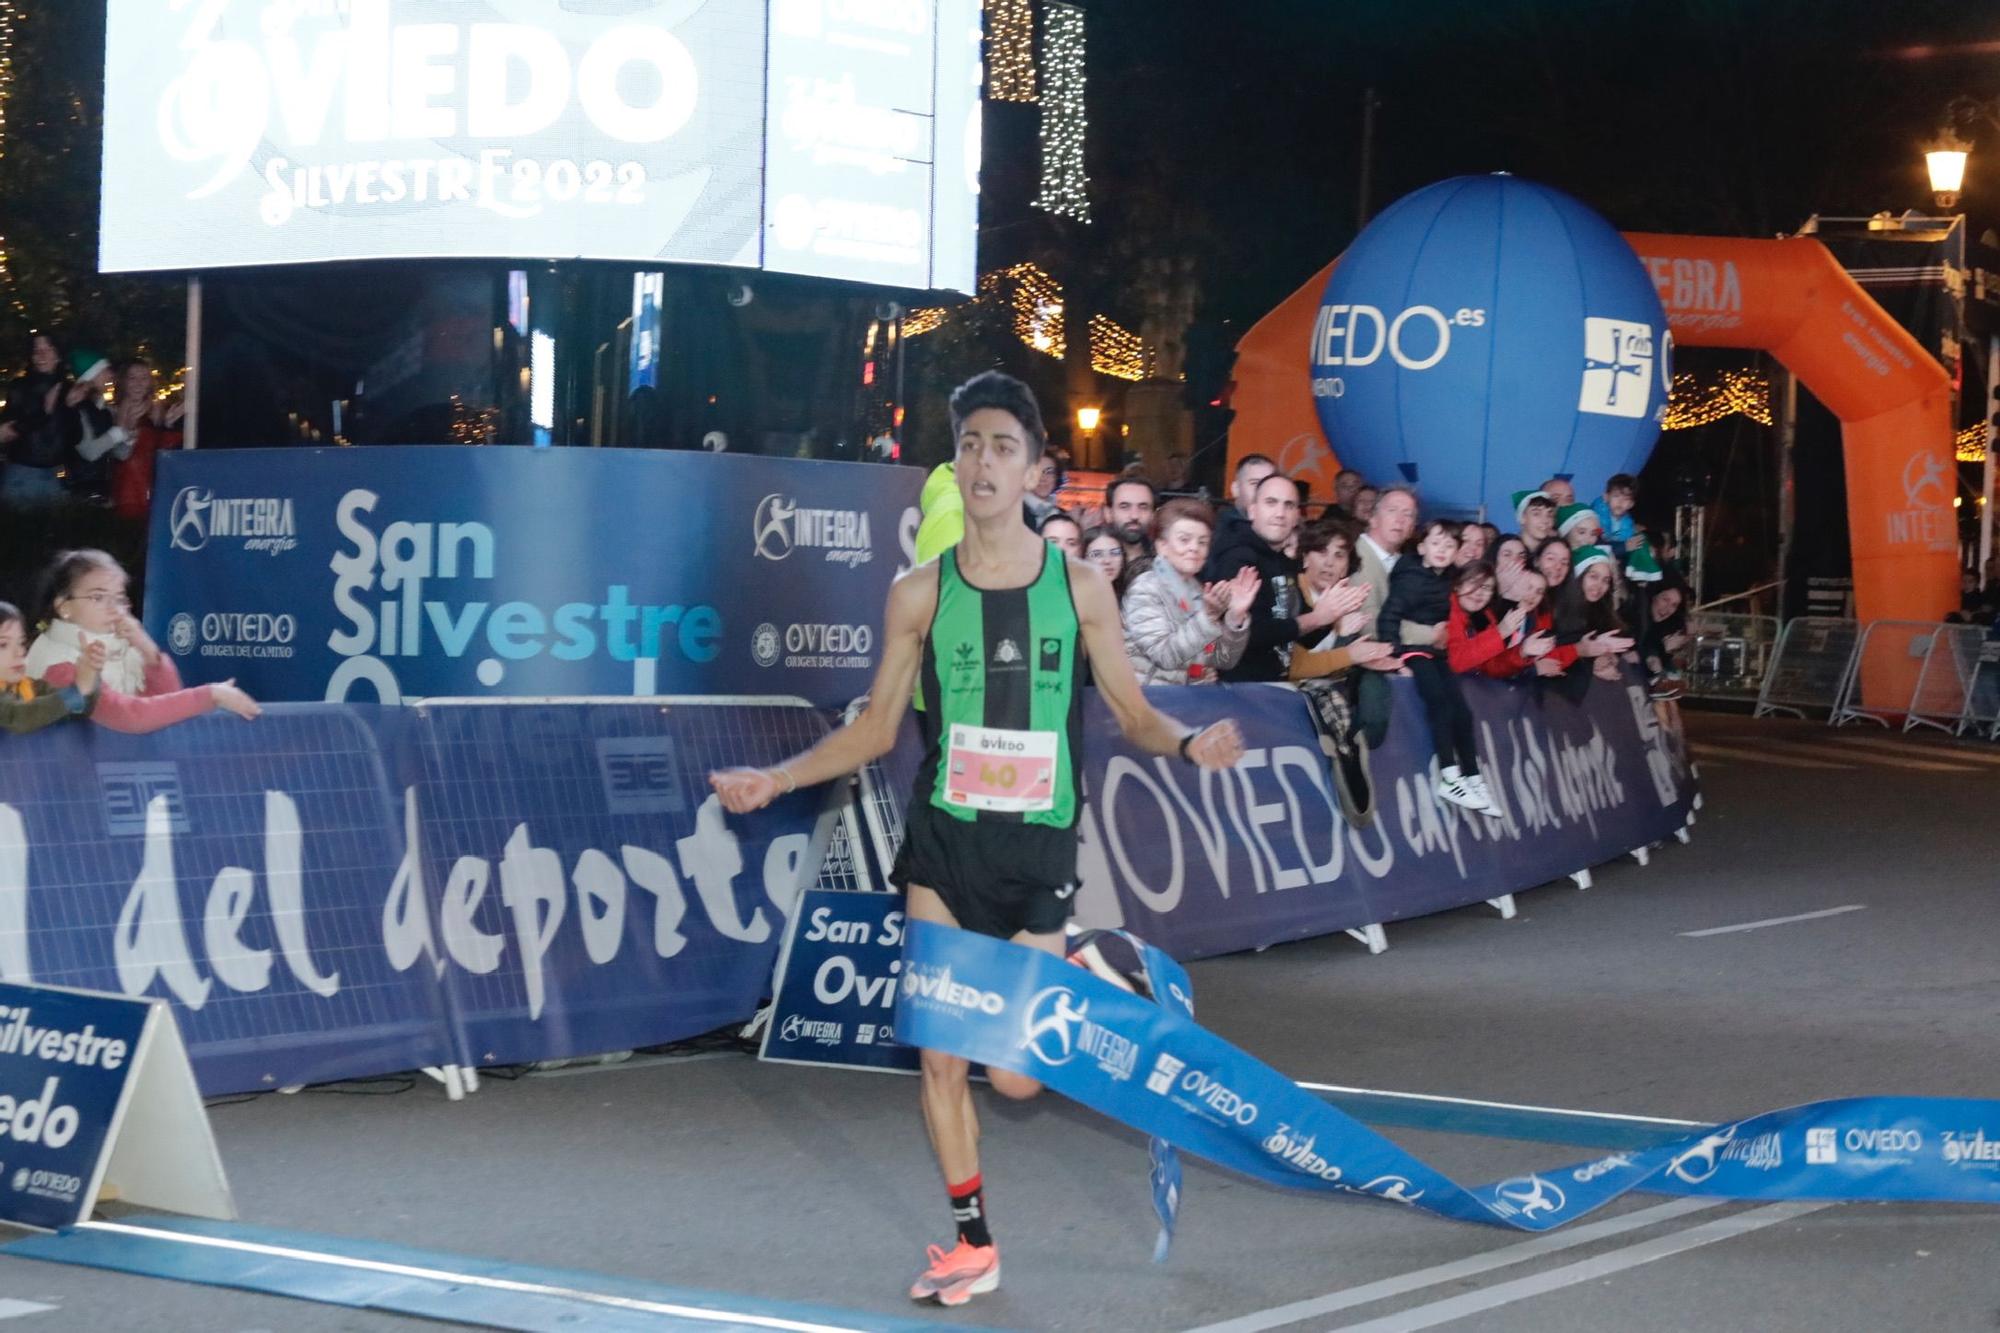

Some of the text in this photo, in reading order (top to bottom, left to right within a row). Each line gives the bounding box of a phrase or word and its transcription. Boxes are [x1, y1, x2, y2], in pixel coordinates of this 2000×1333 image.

[1640, 255, 1743, 312] EGRA
[209, 498, 296, 537] INTEGRA
[329, 488, 494, 579] San
[793, 508, 872, 549] INTEGRA
[201, 612, 297, 643] OVIEDO
[327, 570, 722, 663] Silvestre
[786, 623, 873, 654] OVIEDO
[113, 789, 340, 1011] del
[382, 784, 810, 1021] deporte
[804, 907, 870, 944] San
[813, 955, 903, 1009] Ovi
[903, 967, 1005, 1016] OVIEDO
[801, 1020, 843, 1039] INTEGRA
[1181, 1070, 1258, 1126] OVIEDO
[1263, 1132, 1343, 1181] OVIEDO
[1844, 1128, 1922, 1152] OVIEDO
[1941, 1127, 2000, 1166] OVIED
